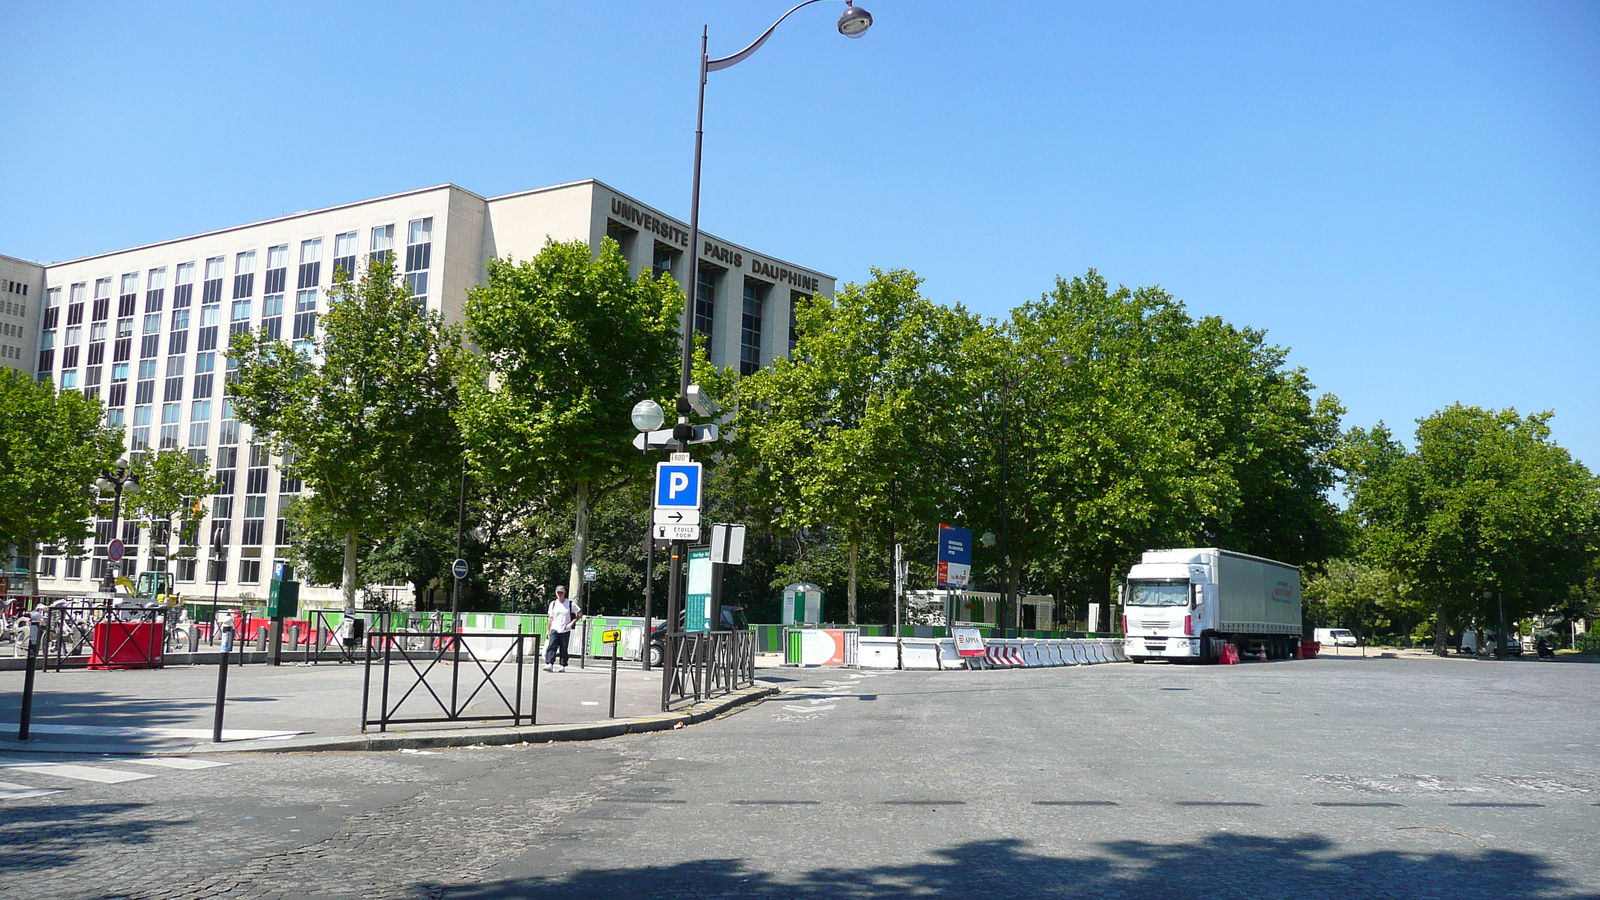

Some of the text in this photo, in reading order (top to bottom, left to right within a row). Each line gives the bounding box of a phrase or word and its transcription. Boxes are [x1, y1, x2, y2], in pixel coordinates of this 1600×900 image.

[611, 198, 819, 292] UNIVERSITE PARIS DAUPHINE
[669, 472, 689, 499] P
